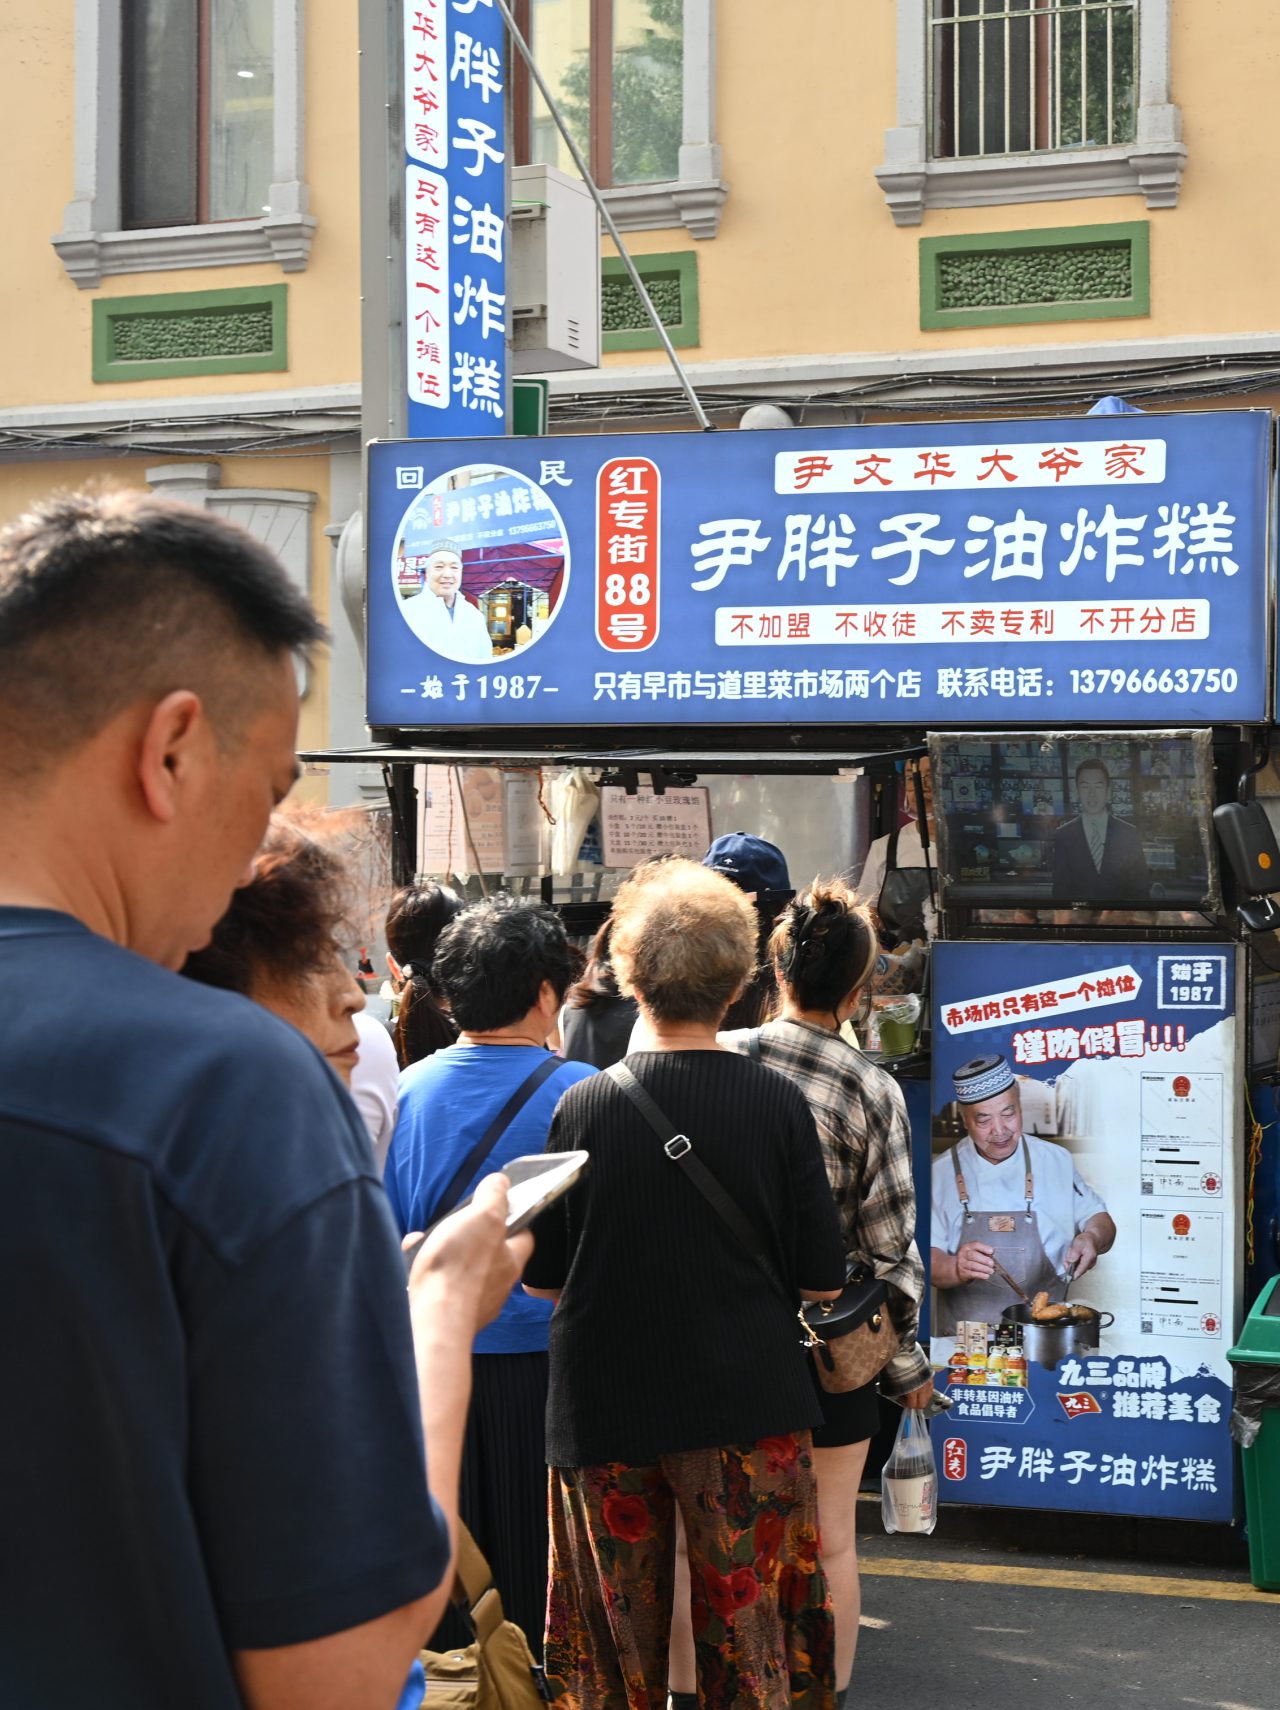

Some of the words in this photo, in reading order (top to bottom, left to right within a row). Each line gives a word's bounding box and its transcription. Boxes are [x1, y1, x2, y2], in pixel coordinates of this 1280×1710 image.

[413, 0, 440, 154] 华大爷家
[450, 0, 505, 418] 胖子油炸糕
[415, 179, 441, 398] 只有这一个摊位
[395, 466, 424, 490] 回
[539, 460, 573, 487] 民
[793, 443, 1147, 490] 尹文华大爷家
[605, 466, 650, 643] 红专街88号
[690, 501, 1239, 592] 尹胖子油炸糕
[731, 613, 811, 640] 不加盟
[835, 612, 917, 638] 不收徒
[941, 609, 1055, 636] 不卖专利
[1079, 606, 1196, 634] 不开分店
[593, 669, 922, 701] 只有早市与道里菜市场两个店
[1069, 667, 1238, 694] 13796663750
[1170, 962, 1213, 983] 始于
[946, 974, 1137, 1029] 市场内只有这一个摊位
[1170, 986, 1214, 1002] 1987
[1059, 1358, 1168, 1390] 九三品牌
[951, 1388, 1025, 1405] 非转基因油炸
[957, 1402, 1018, 1418] 食品倡导者
[1113, 1391, 1221, 1424] 推荐美食
[980, 1446, 1218, 1493] 尹胖子油炸糕
